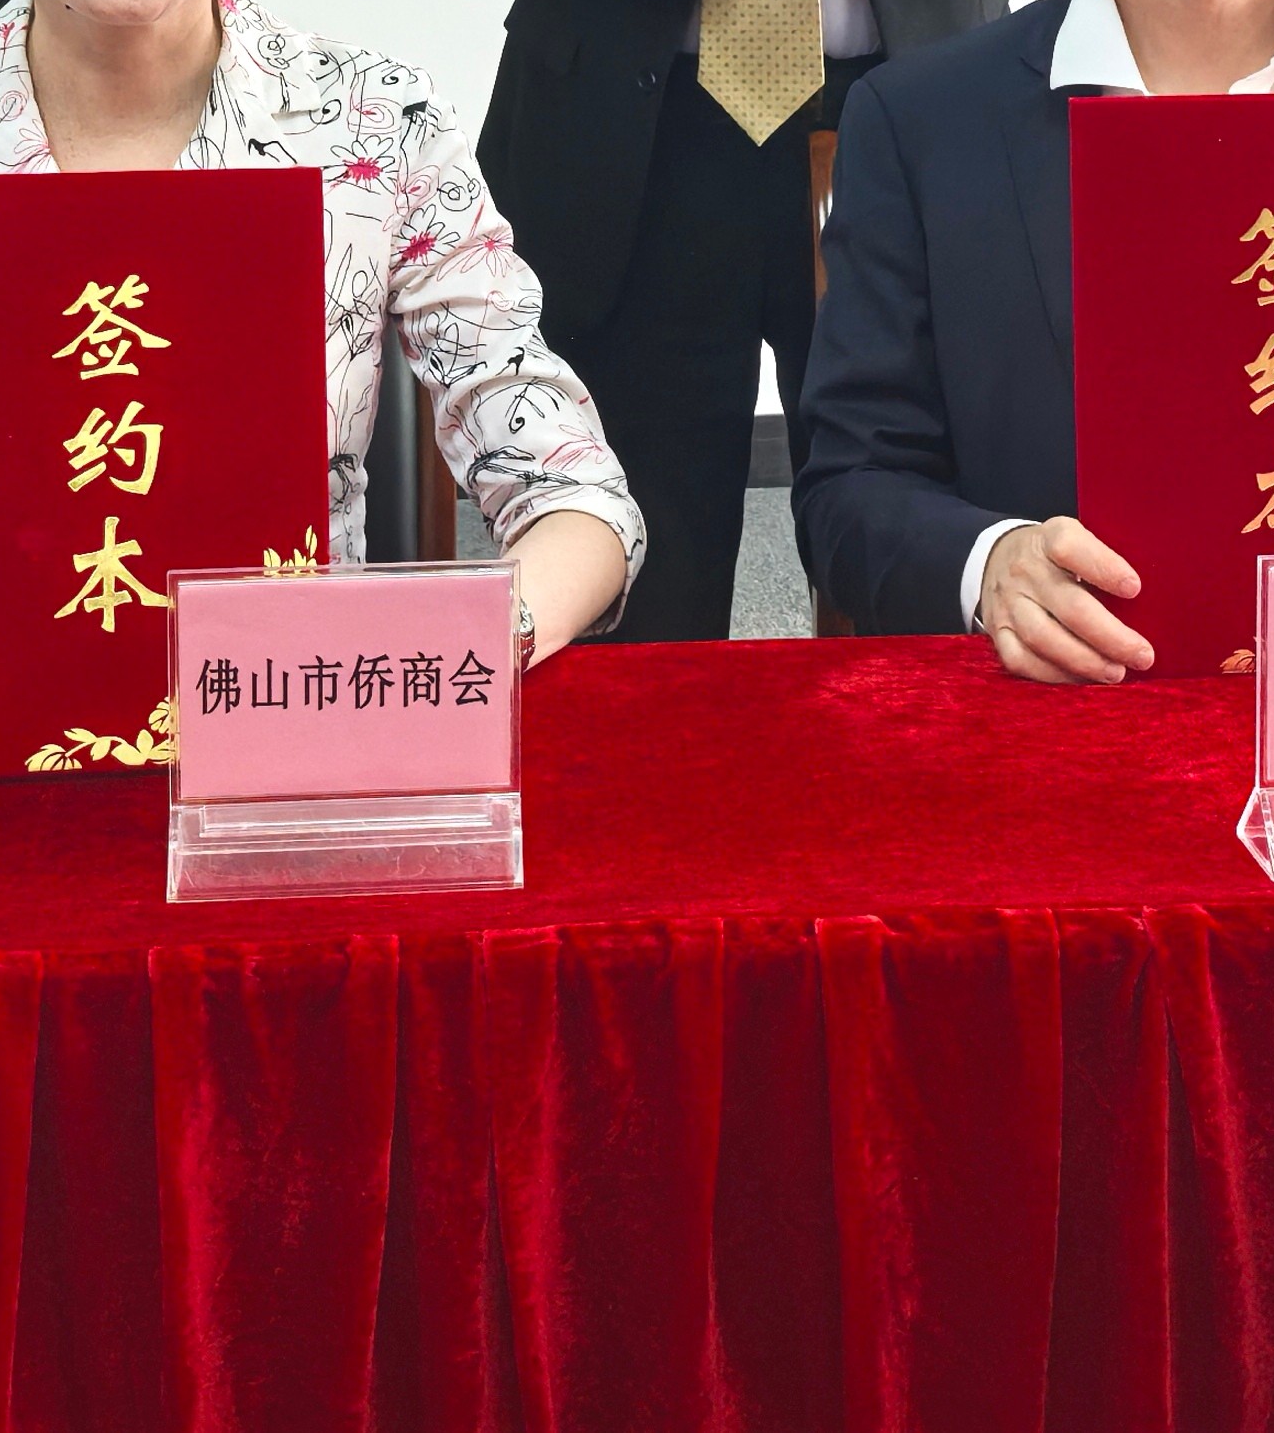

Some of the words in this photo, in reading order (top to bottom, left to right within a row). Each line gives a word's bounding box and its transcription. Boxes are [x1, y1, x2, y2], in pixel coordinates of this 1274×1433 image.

[51, 274, 170, 634] 签约本
[195, 649, 496, 715] 佛山市侨商会
